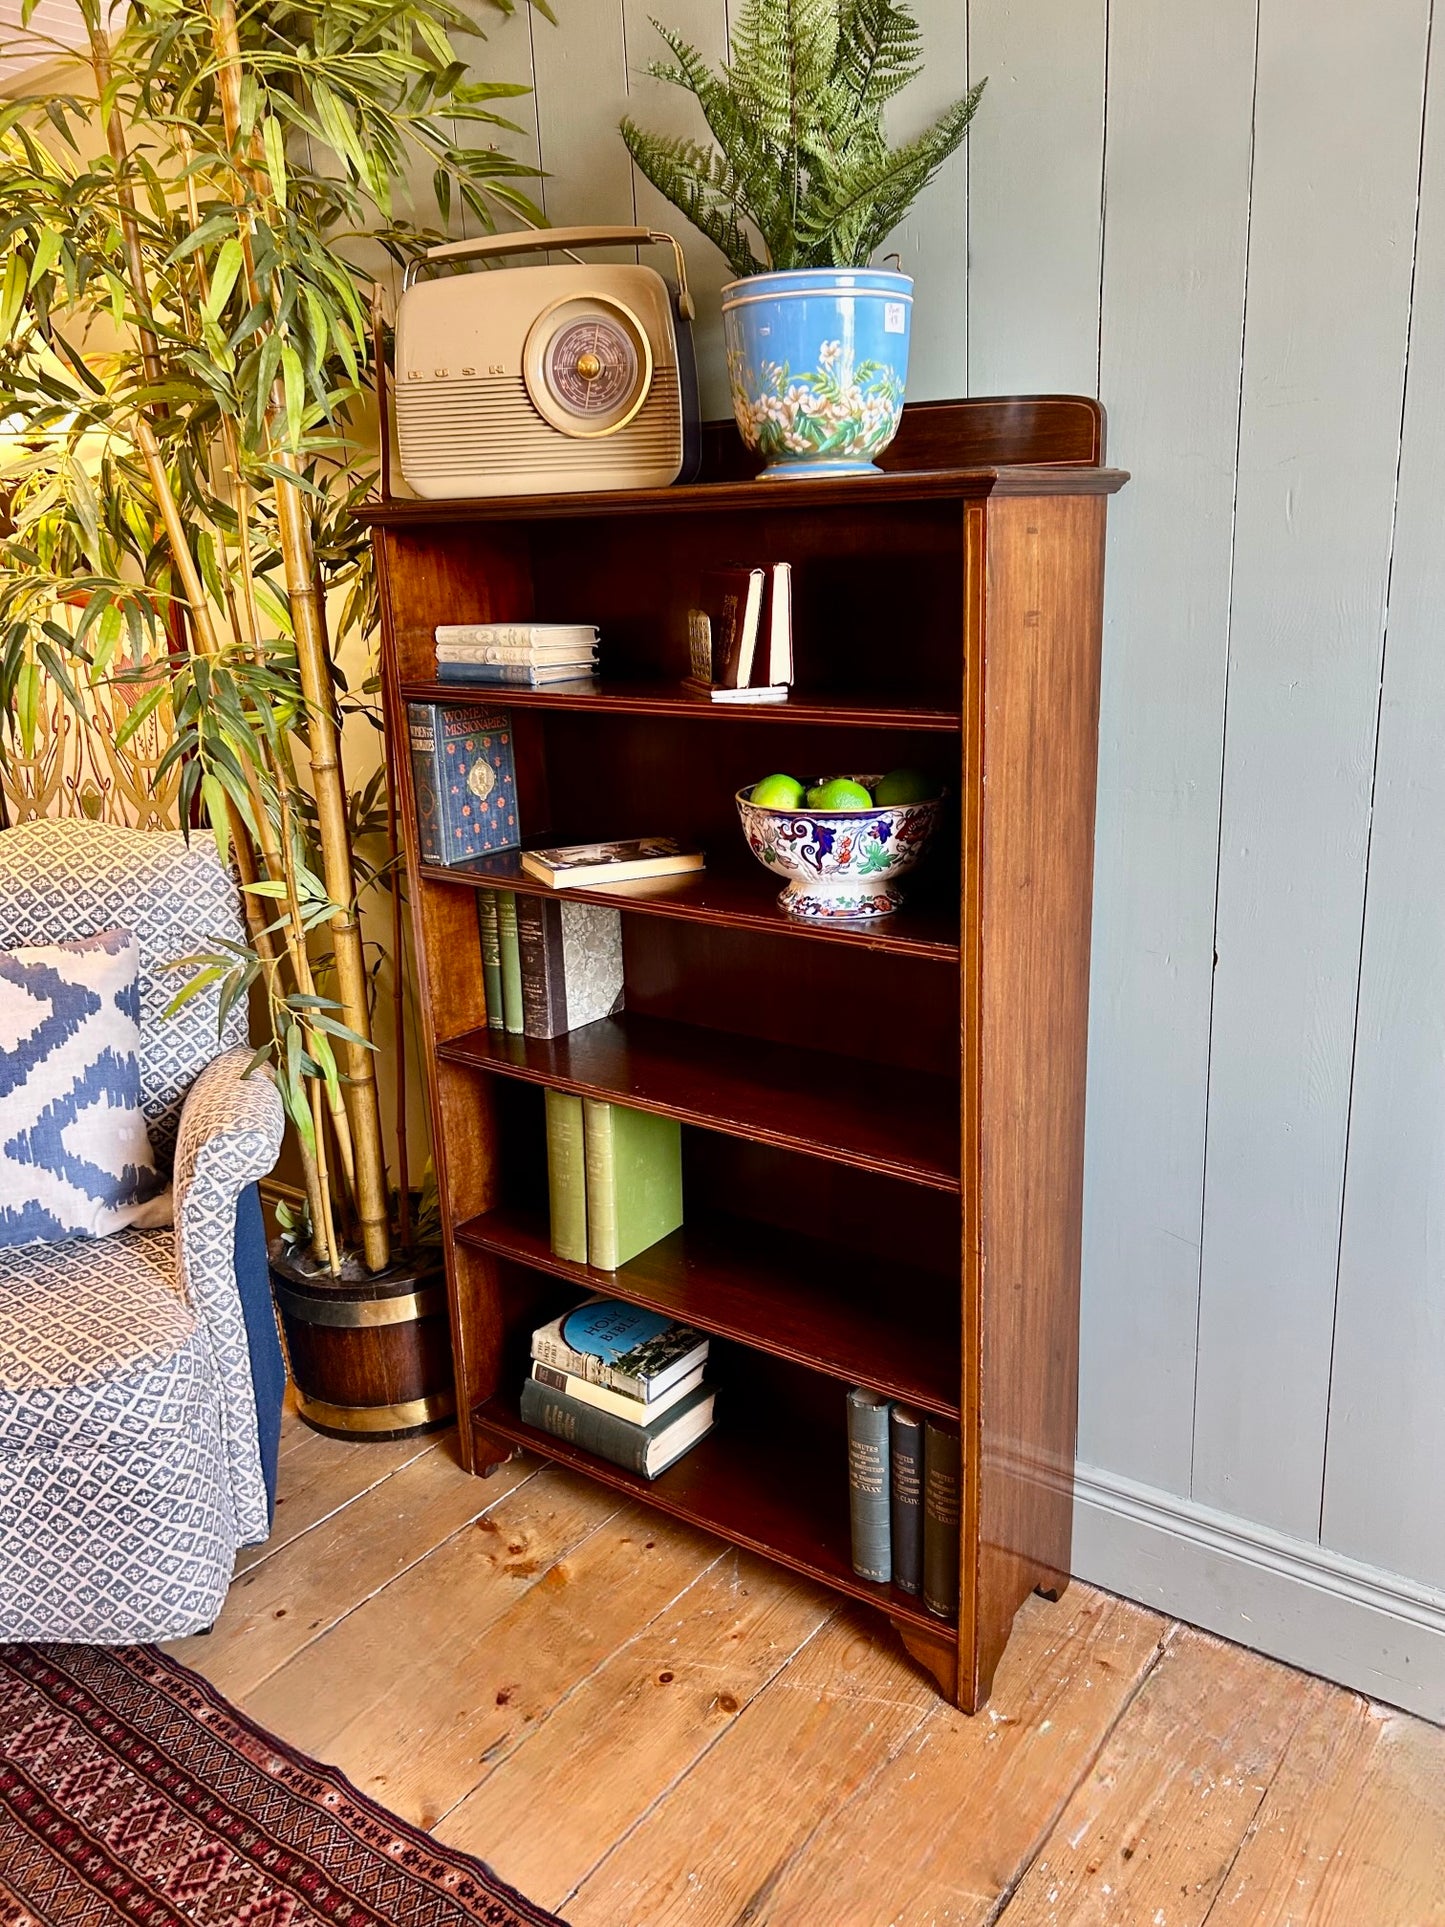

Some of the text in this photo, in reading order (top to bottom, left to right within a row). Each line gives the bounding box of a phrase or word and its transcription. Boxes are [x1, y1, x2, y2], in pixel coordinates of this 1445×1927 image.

[407, 364, 505, 380] BUSH
[442, 705, 489, 723] WOMEN
[444, 714, 508, 737] MISSIONARIES
[584, 1310, 621, 1336] HOLY
[600, 1317, 641, 1342] BIBLE
